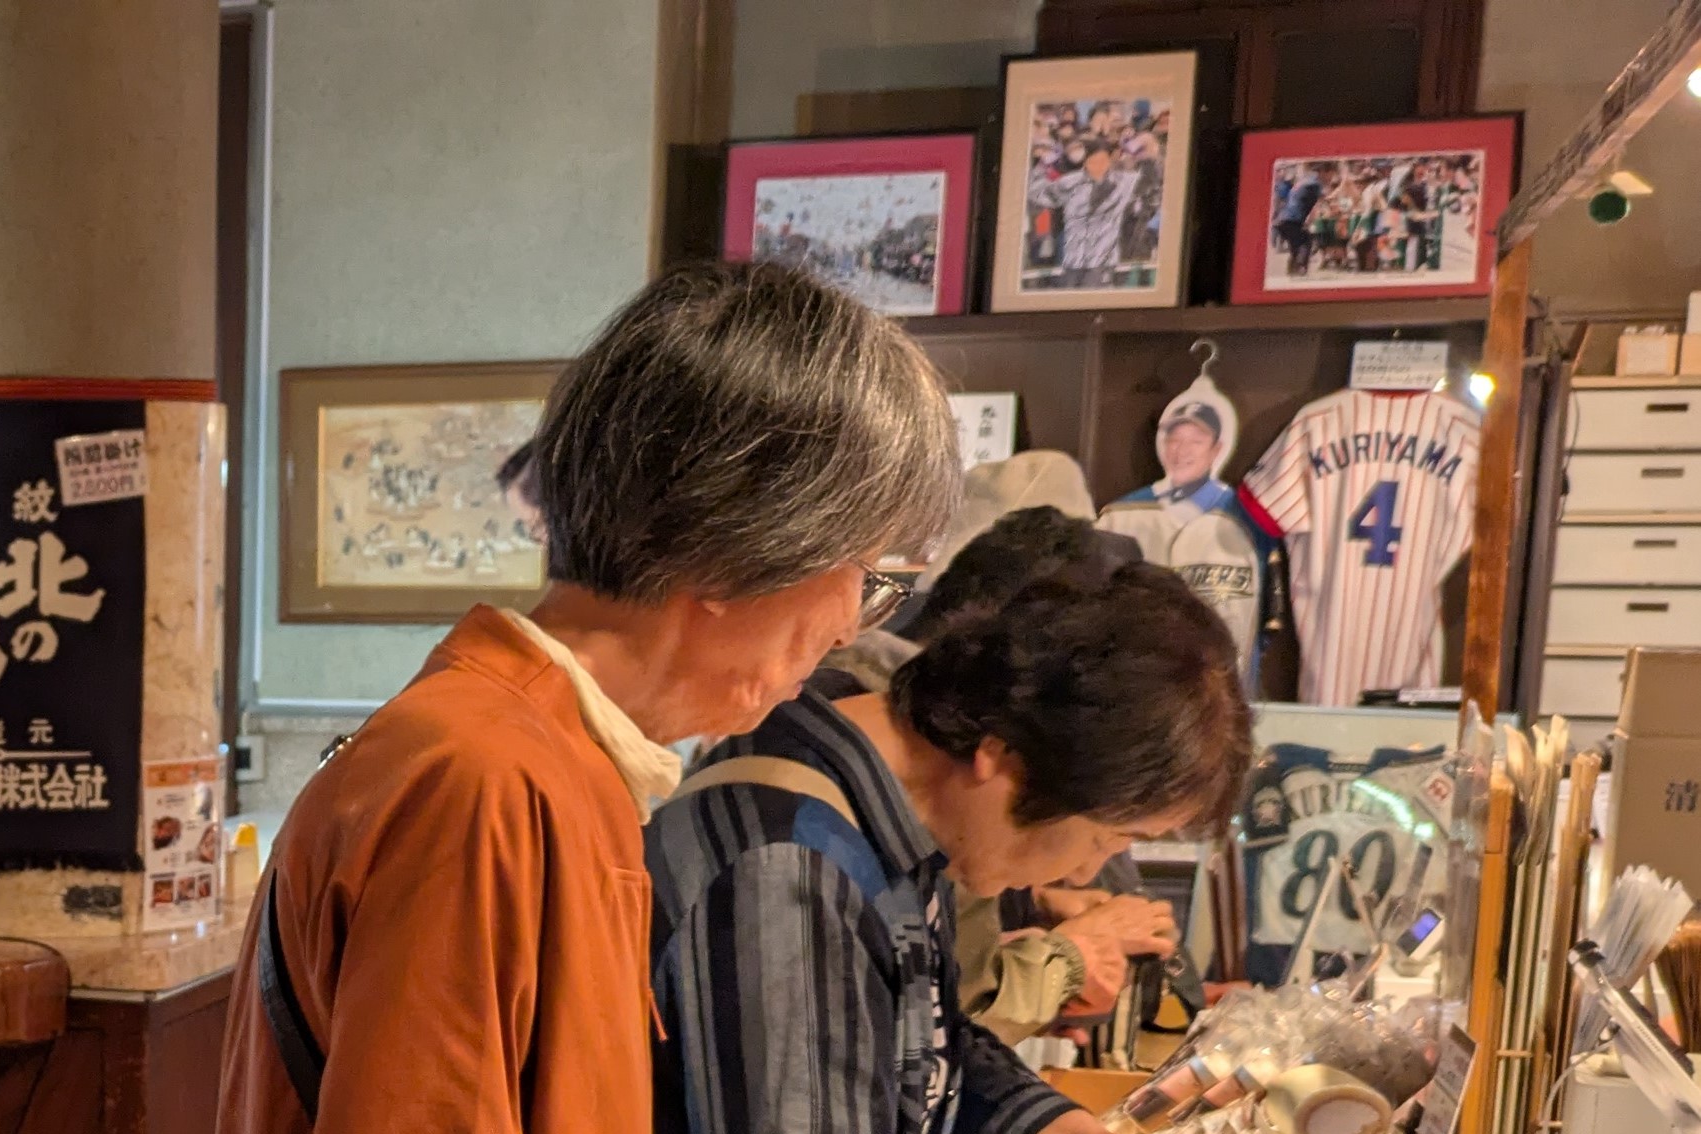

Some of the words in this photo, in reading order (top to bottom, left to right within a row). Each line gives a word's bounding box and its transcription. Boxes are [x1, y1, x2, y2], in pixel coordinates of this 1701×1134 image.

[1308, 431, 1463, 485] KURIYAMA
[1348, 480, 1403, 568] 4
[1280, 829, 1396, 921] 80
